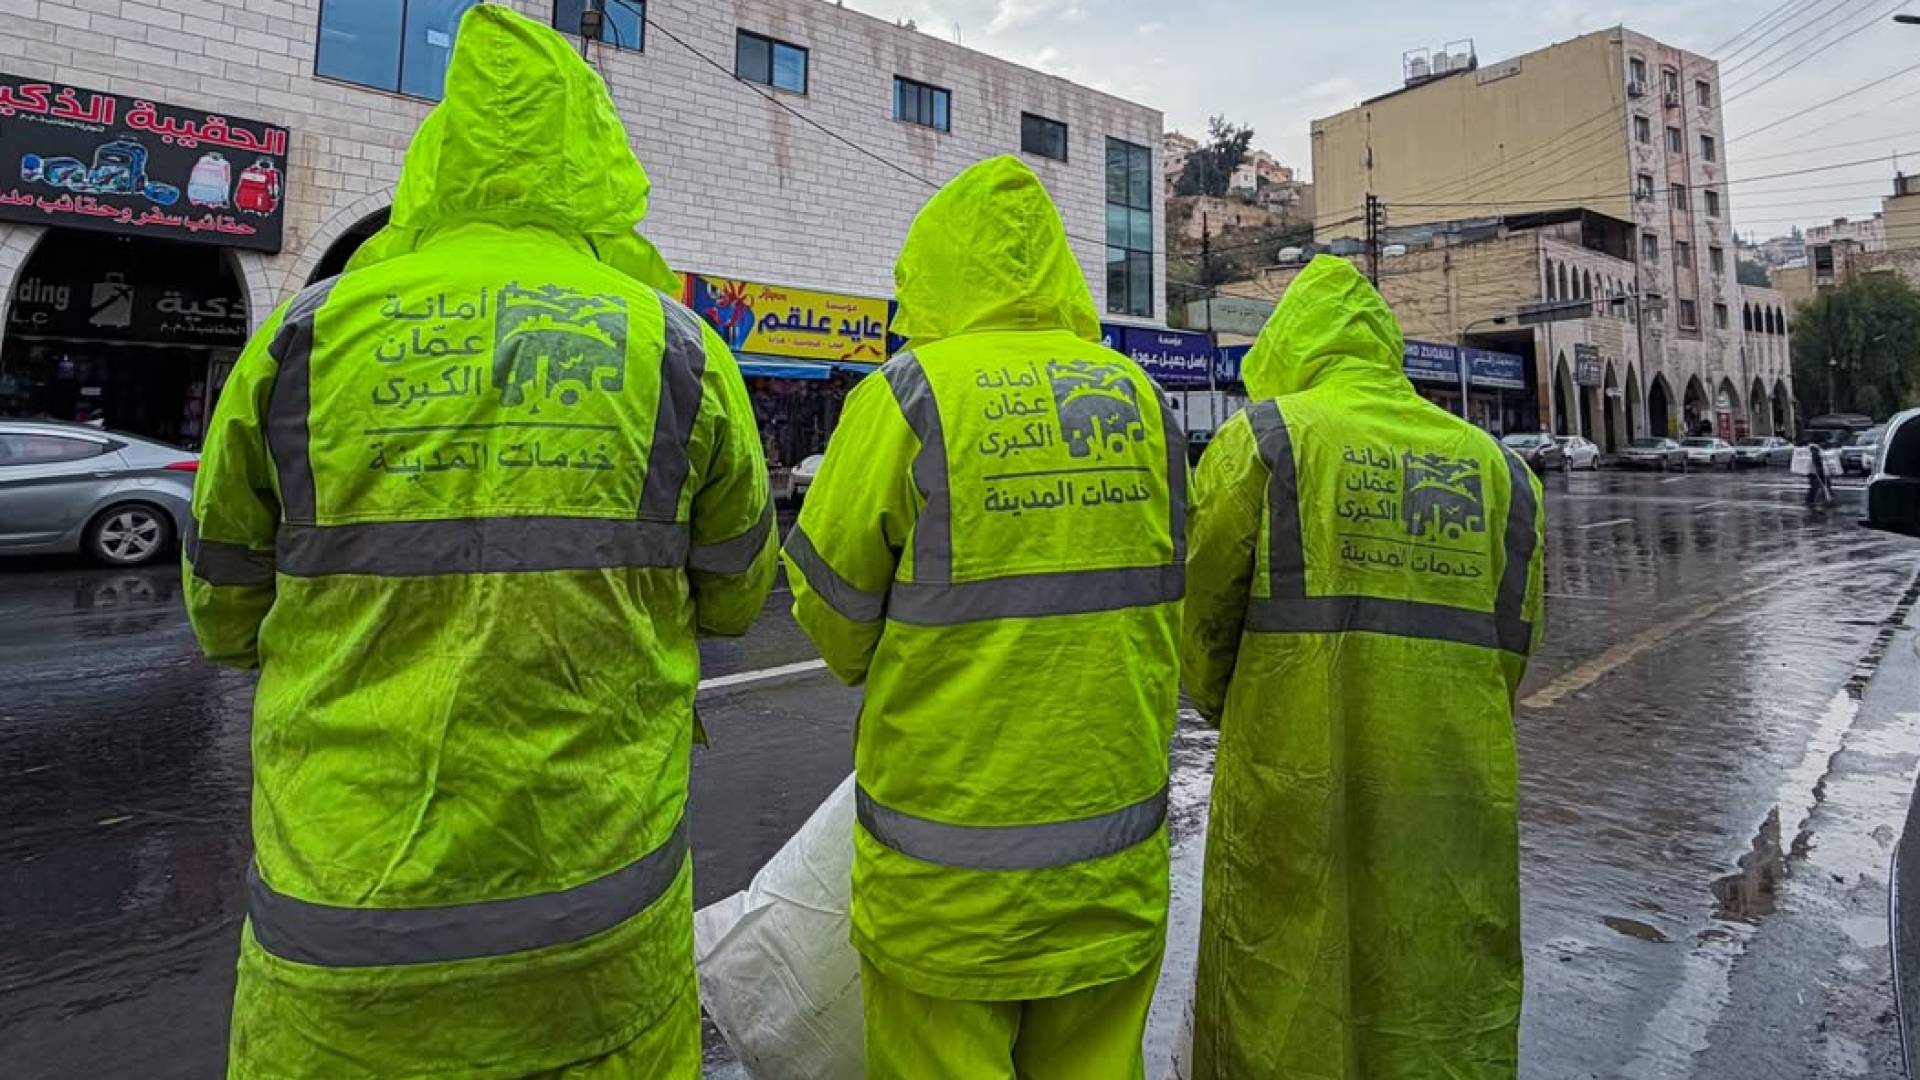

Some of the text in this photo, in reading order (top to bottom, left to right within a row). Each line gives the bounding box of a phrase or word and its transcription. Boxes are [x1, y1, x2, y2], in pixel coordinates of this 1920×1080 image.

[0, 83, 287, 156] الحقيبة الذكي
[135, 207, 182, 226] سفر
[184, 212, 257, 234] حقائب
[19, 277, 70, 312] ding
[156, 290, 248, 322] ذكية
[381, 287, 488, 320] أمانة
[757, 306, 831, 335] علقم
[371, 365, 483, 409] الكبرى
[975, 361, 1041, 388] أمانة
[979, 422, 1053, 458] الكبرى
[368, 440, 615, 481] خدمات المدينة
[1343, 444, 1397, 471] أمانة
[984, 479, 1152, 517] خدمات المدينة
[1336, 499, 1397, 523] الكبرى
[1411, 552, 1483, 578] خدمات
